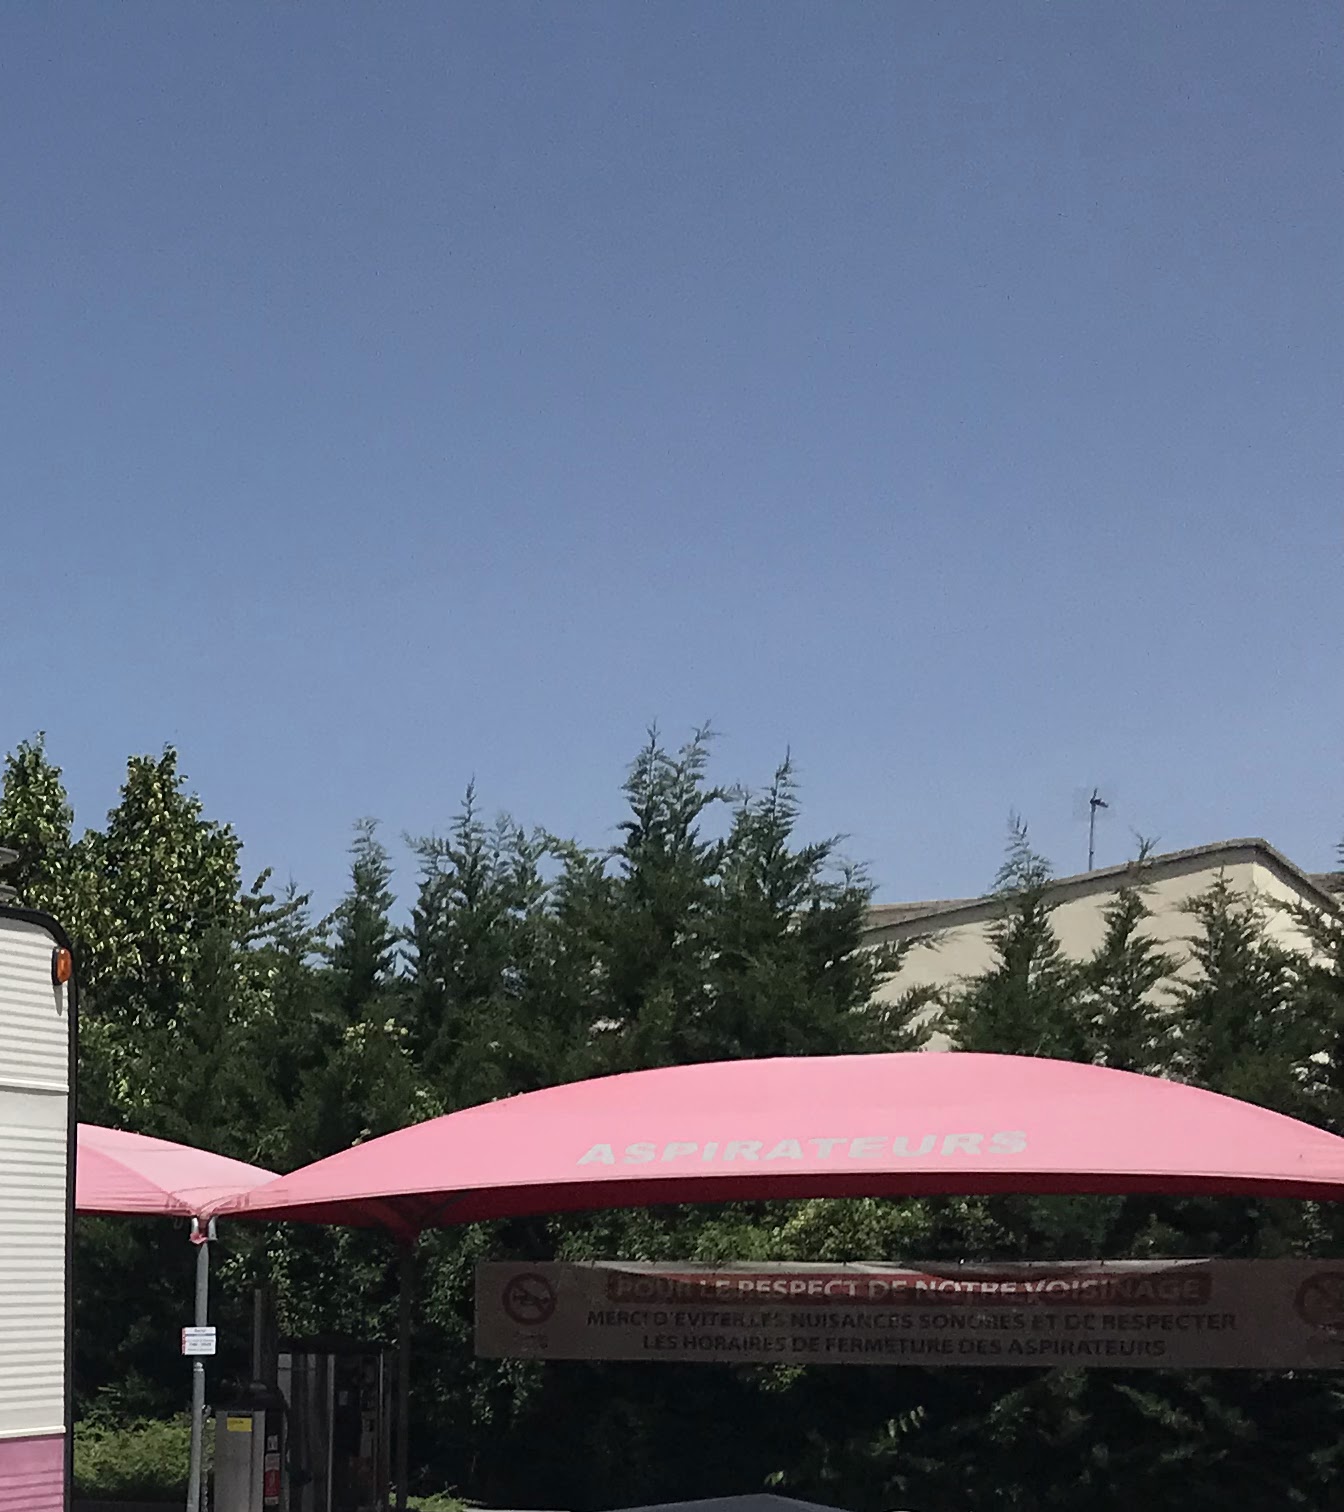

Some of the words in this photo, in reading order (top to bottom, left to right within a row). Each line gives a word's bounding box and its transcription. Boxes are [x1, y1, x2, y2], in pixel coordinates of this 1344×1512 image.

[577, 1129, 1028, 1166] ASPIRATEURS
[737, 1279, 860, 1299] RESPECT
[867, 1279, 909, 1300] DE
[914, 1280, 1018, 1300] NOTRE
[1023, 1279, 1202, 1299] VOISINAGE
[790, 1312, 913, 1329] NUISANCES
[1031, 1313, 1061, 1330] ET
[1102, 1314, 1238, 1331] RESPECTER
[682, 1335, 787, 1352] HORAIRES
[791, 1336, 820, 1352] DE
[825, 1336, 954, 1354] FERMETURE
[958, 1337, 1002, 1355] DES
[1007, 1338, 1166, 1357] ASPIRATEURS
